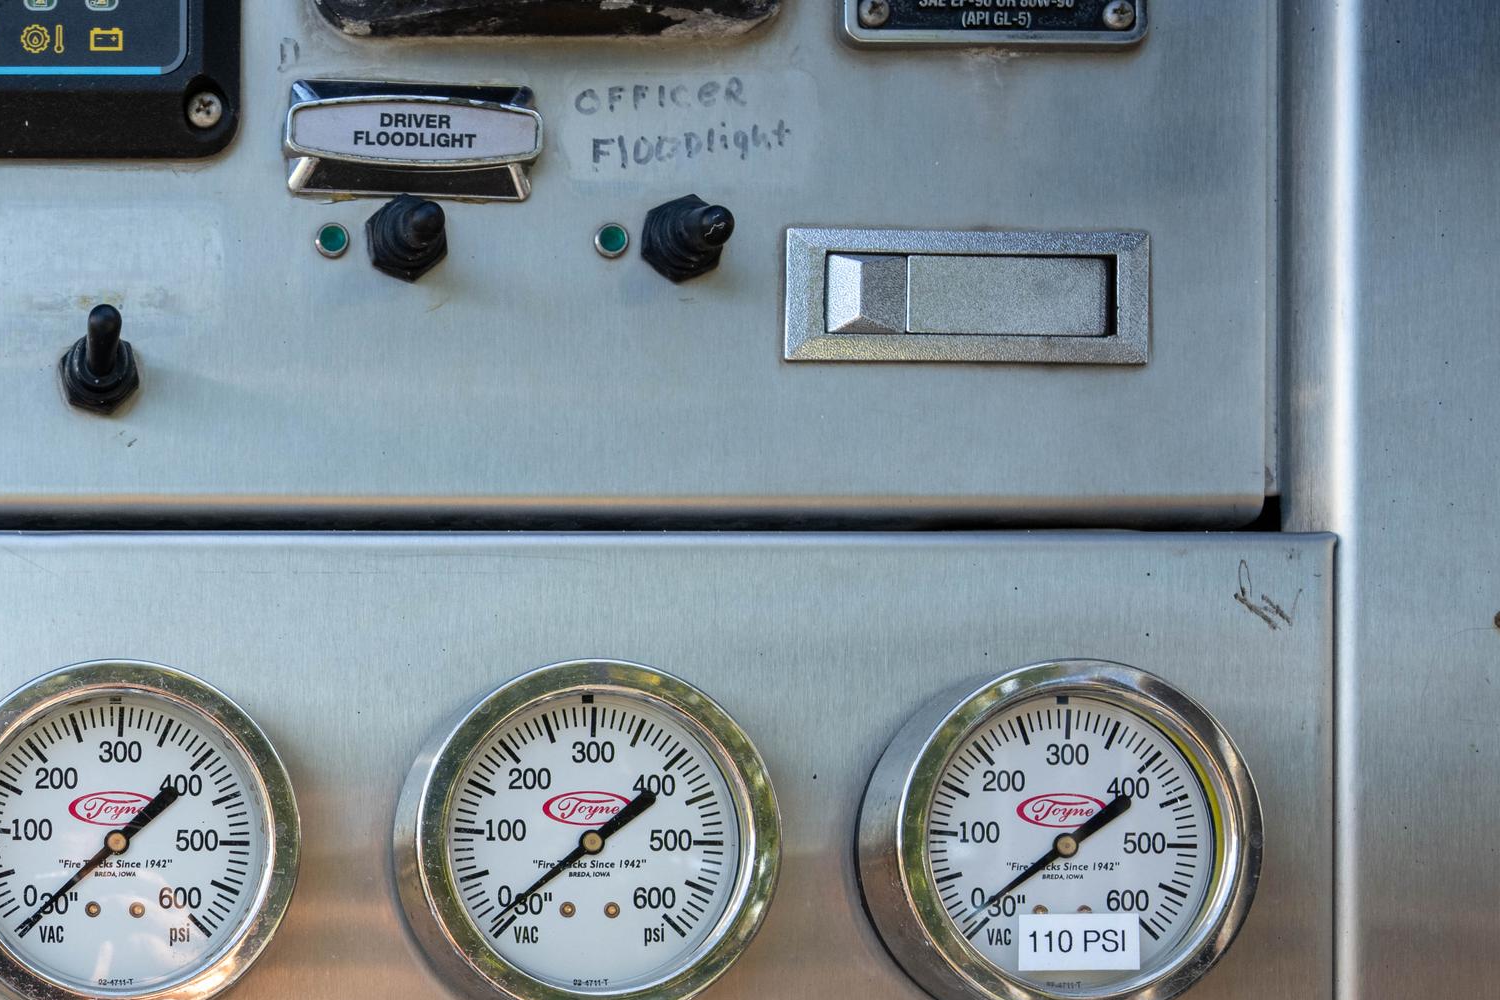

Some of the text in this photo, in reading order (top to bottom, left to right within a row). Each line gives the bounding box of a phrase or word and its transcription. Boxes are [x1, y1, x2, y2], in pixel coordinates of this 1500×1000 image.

[962, 11, 1032, 28] (API GL-5)
[380, 113, 451, 129] DRIVER
[353, 130, 477, 149] FLOODLIGHT
[99, 741, 142, 763] 300
[572, 741, 615, 763] 300
[1046, 744, 1089, 766] 300
[35, 767, 78, 789] 200
[159, 775, 202, 797] 400
[508, 768, 551, 790] 200
[633, 775, 676, 797] 400
[982, 770, 1025, 792] 200
[1107, 777, 1149, 799] 400
[558, 797, 620, 820] Toyne
[1032, 799, 1094, 822] Toyne
[11, 819, 53, 841] 100
[175, 829, 218, 851] 500
[485, 819, 526, 841] 100
[650, 829, 692, 851] 500
[958, 822, 999, 843] 100
[1123, 832, 1166, 854] 500
[116, 859, 141, 869] Since
[145, 859, 173, 869] 1942"
[590, 859, 615, 869] Since
[619, 859, 647, 869] 1942"
[1063, 861, 1088, 871] Since
[1093, 861, 1120, 871] 1942"
[23, 885, 37, 907] 0
[159, 887, 202, 909] 600
[498, 885, 511, 907] 0
[514, 892, 552, 915] 30"
[633, 887, 676, 909] 600
[971, 888, 985, 910] 0
[987, 894, 1026, 918] 30"
[1107, 889, 1149, 912] 600
[39, 925, 64, 944] VAC
[169, 923, 190, 946] psi
[514, 925, 538, 944] VAC
[644, 923, 665, 946] psi
[987, 928, 1012, 946] VAC
[1029, 929, 1126, 953] 110 PSI
